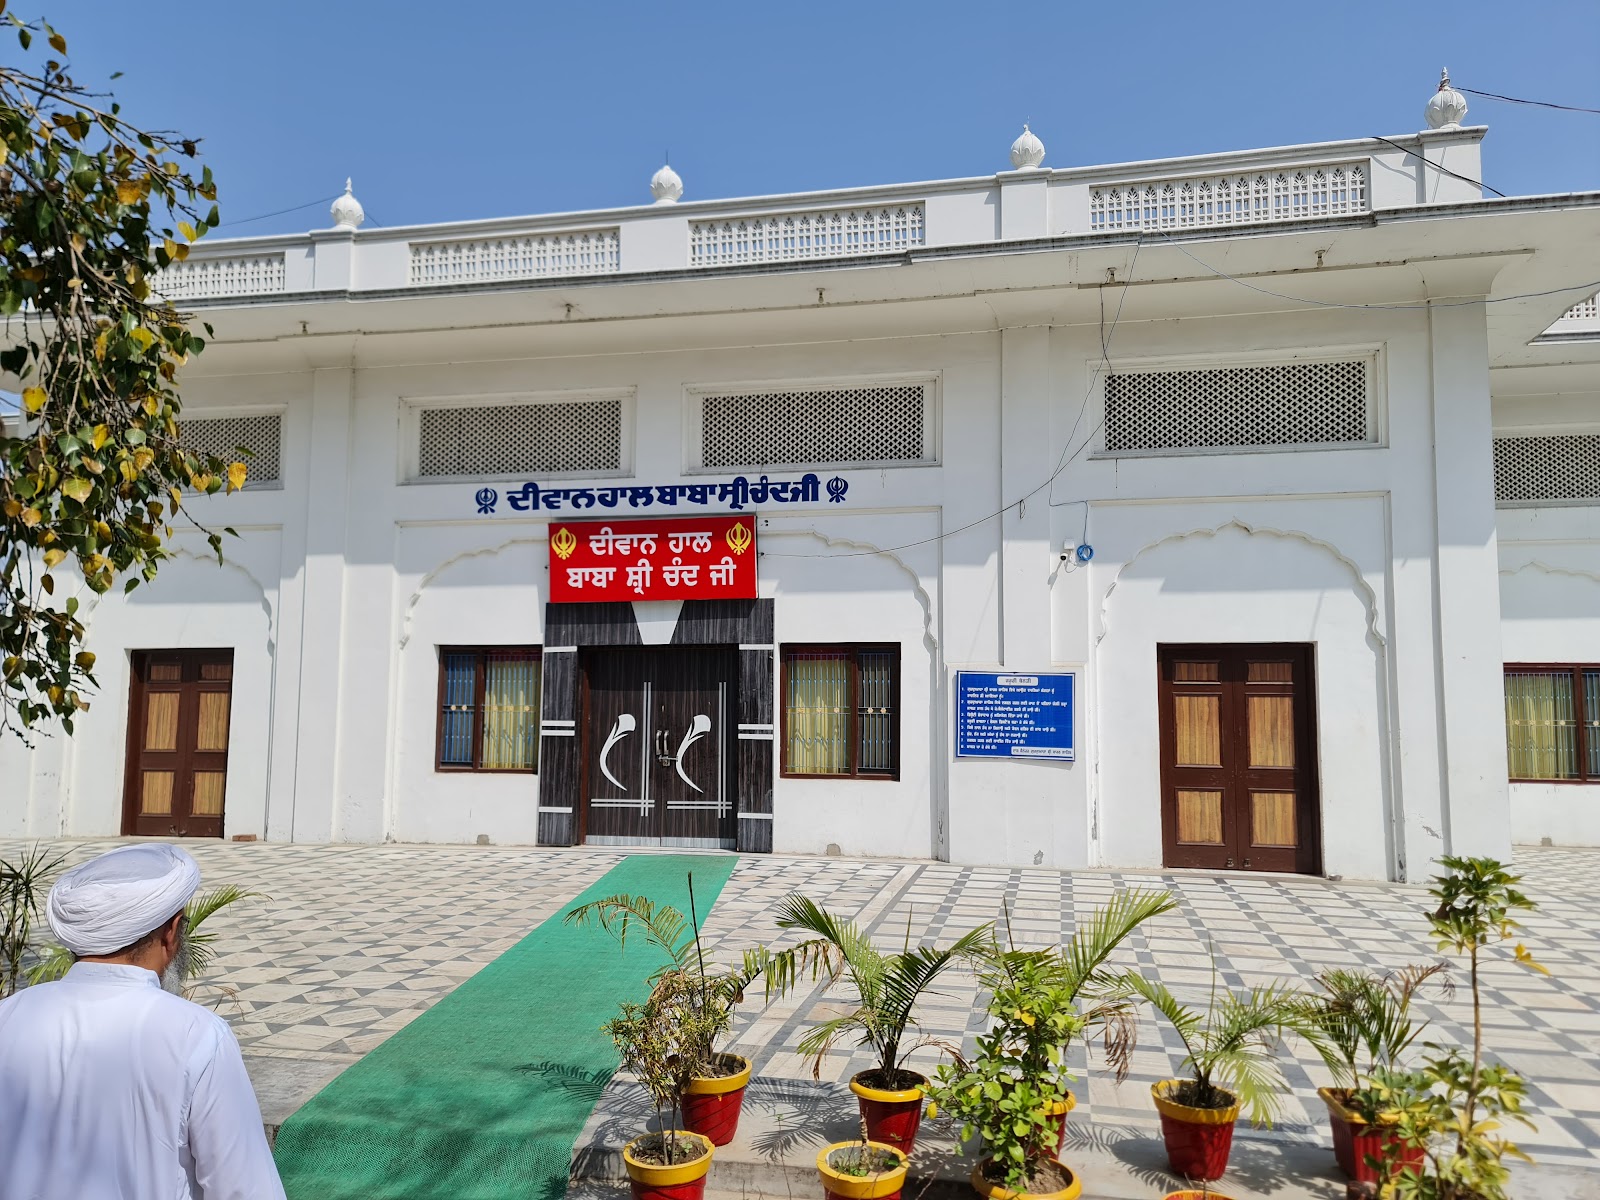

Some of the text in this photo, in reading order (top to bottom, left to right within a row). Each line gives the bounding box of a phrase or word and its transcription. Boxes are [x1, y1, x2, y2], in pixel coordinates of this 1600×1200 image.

[506, 482, 596, 511] ਦੀਵਾਨ
[596, 486, 654, 508] ਹਾਲ
[655, 484, 717, 506] ਬਾਬਾ
[749, 475, 791, 504] ਚੰਦ
[790, 473, 821, 503] ਜੀ
[589, 526, 713, 556] ਦੀਵਾਨ ਹਾਲ
[566, 556, 737, 595] ਬਾਬਾ ਸ਼੍ਰੀ ਚੰਦ ਜੀ
